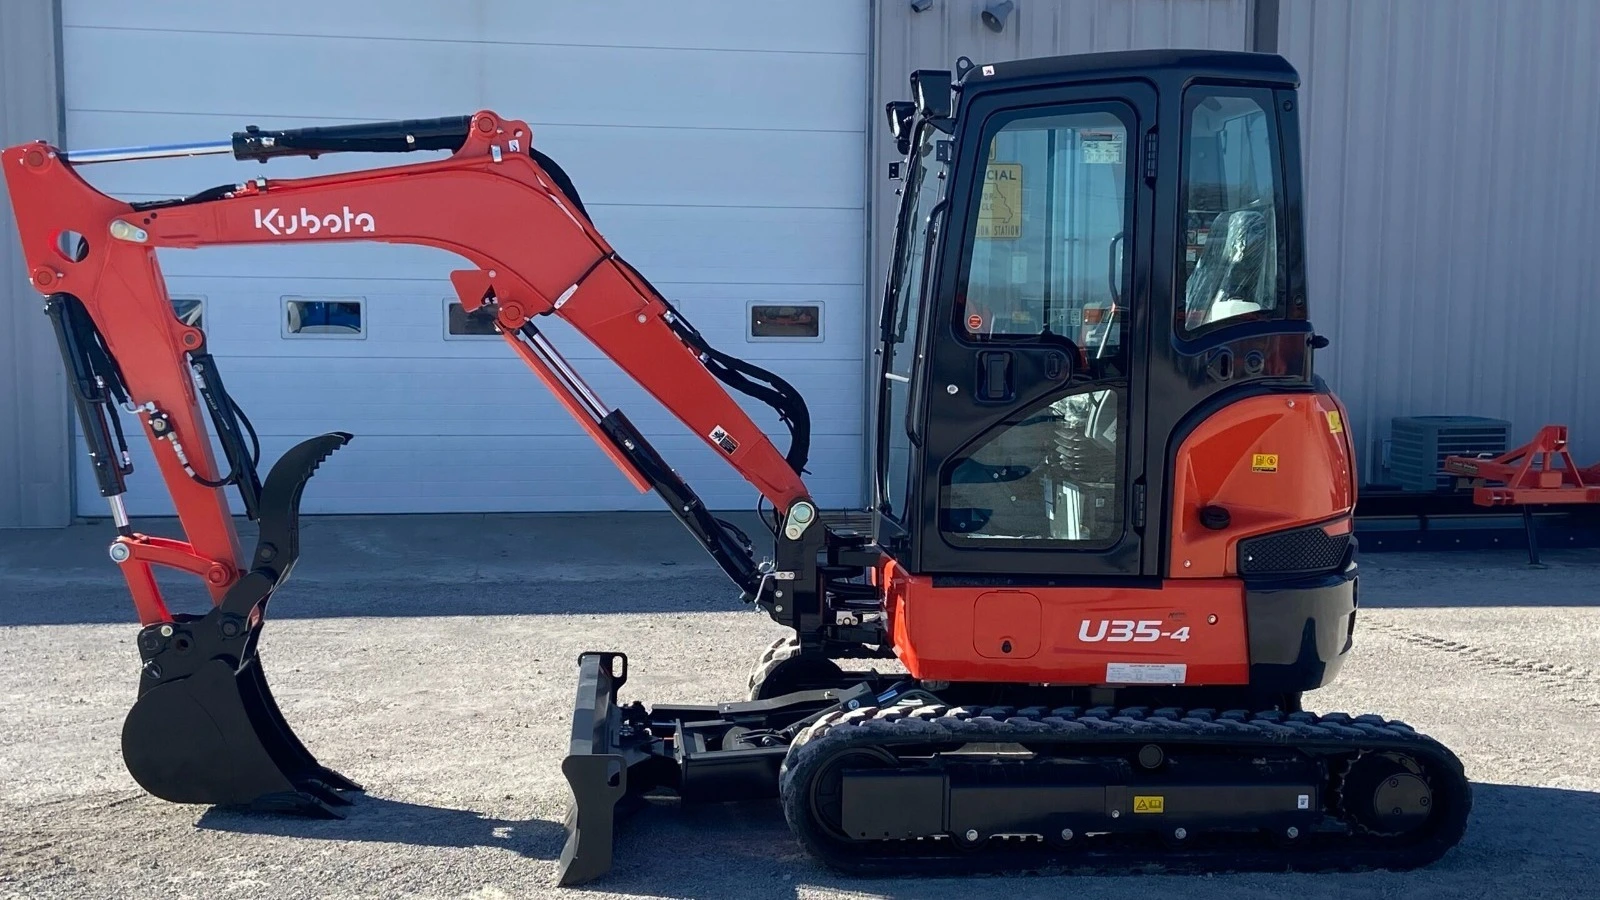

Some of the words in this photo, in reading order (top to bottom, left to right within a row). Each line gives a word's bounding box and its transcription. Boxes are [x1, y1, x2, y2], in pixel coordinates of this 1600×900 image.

[254, 206, 375, 235] Kubota
[994, 225, 1020, 236] STATION
[1078, 620, 1190, 642] U35-4
